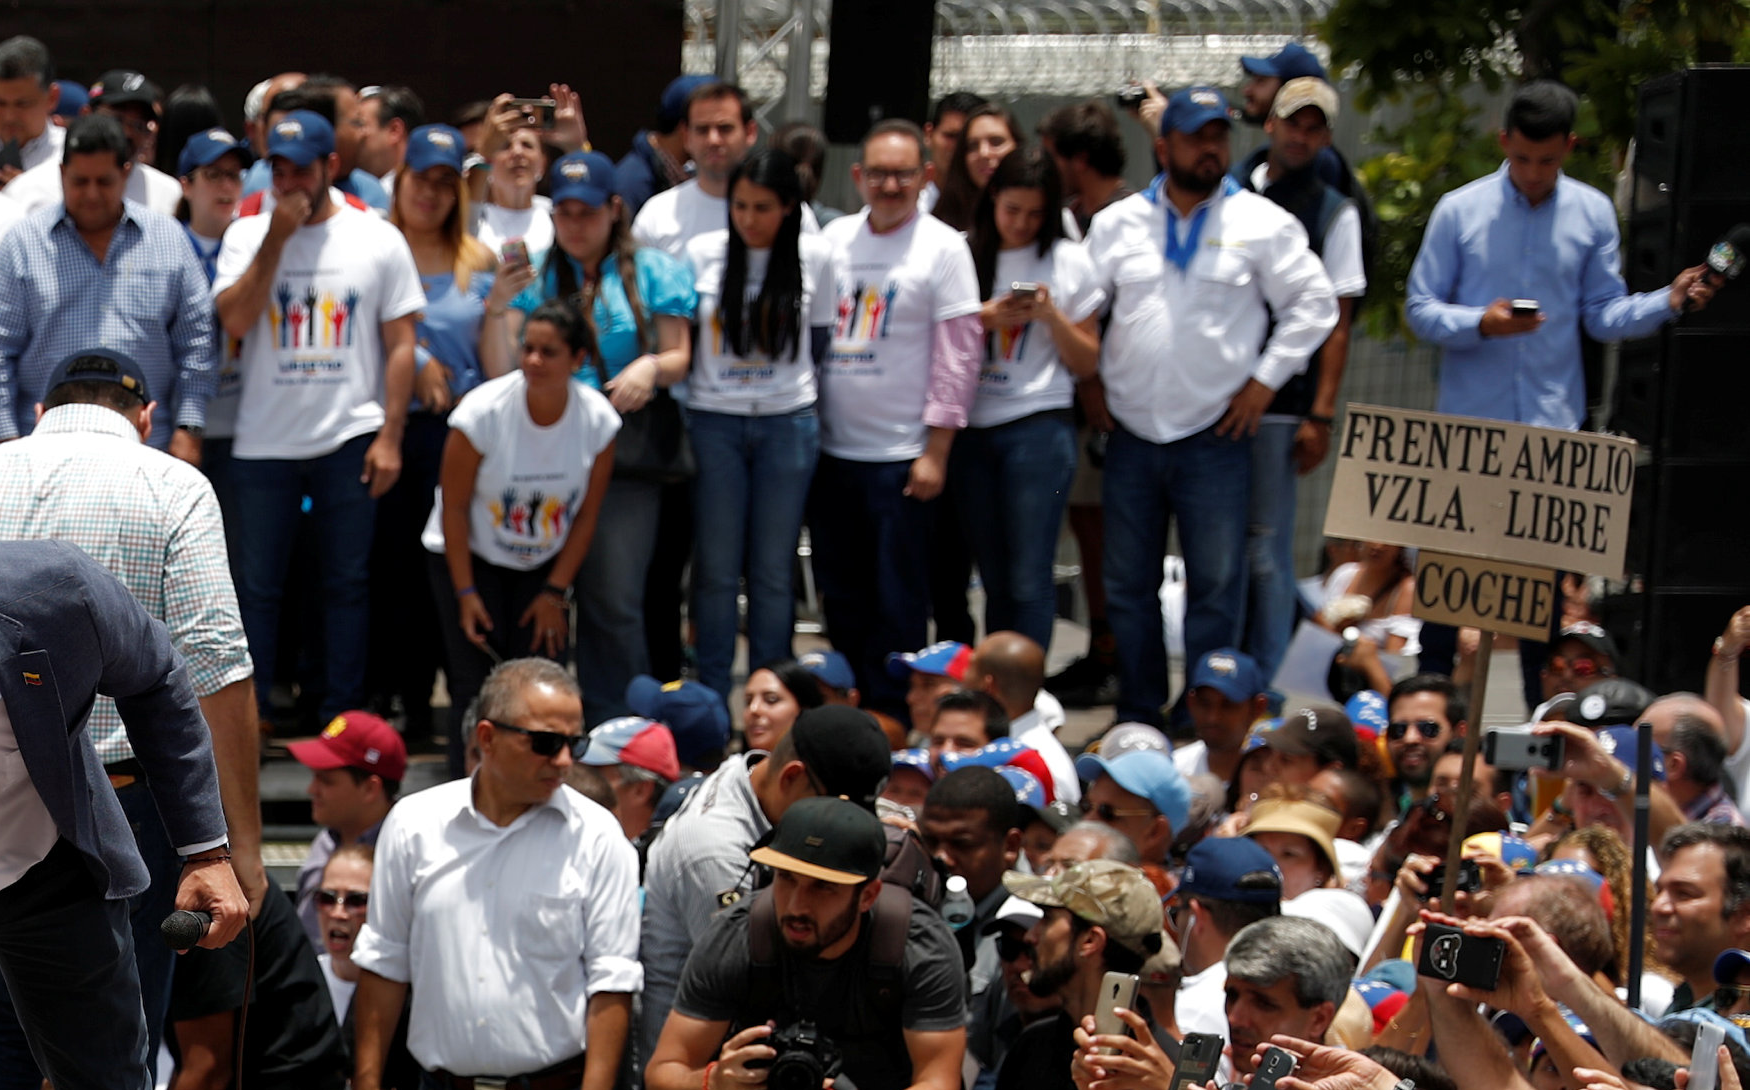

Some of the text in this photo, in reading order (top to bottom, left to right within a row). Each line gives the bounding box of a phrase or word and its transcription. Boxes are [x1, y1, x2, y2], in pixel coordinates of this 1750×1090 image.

[1342, 412, 1634, 496] FRENTE AMPLIO
[1365, 472, 1611, 555] VZLA. LIBRE
[1416, 562, 1553, 628] COCHE
